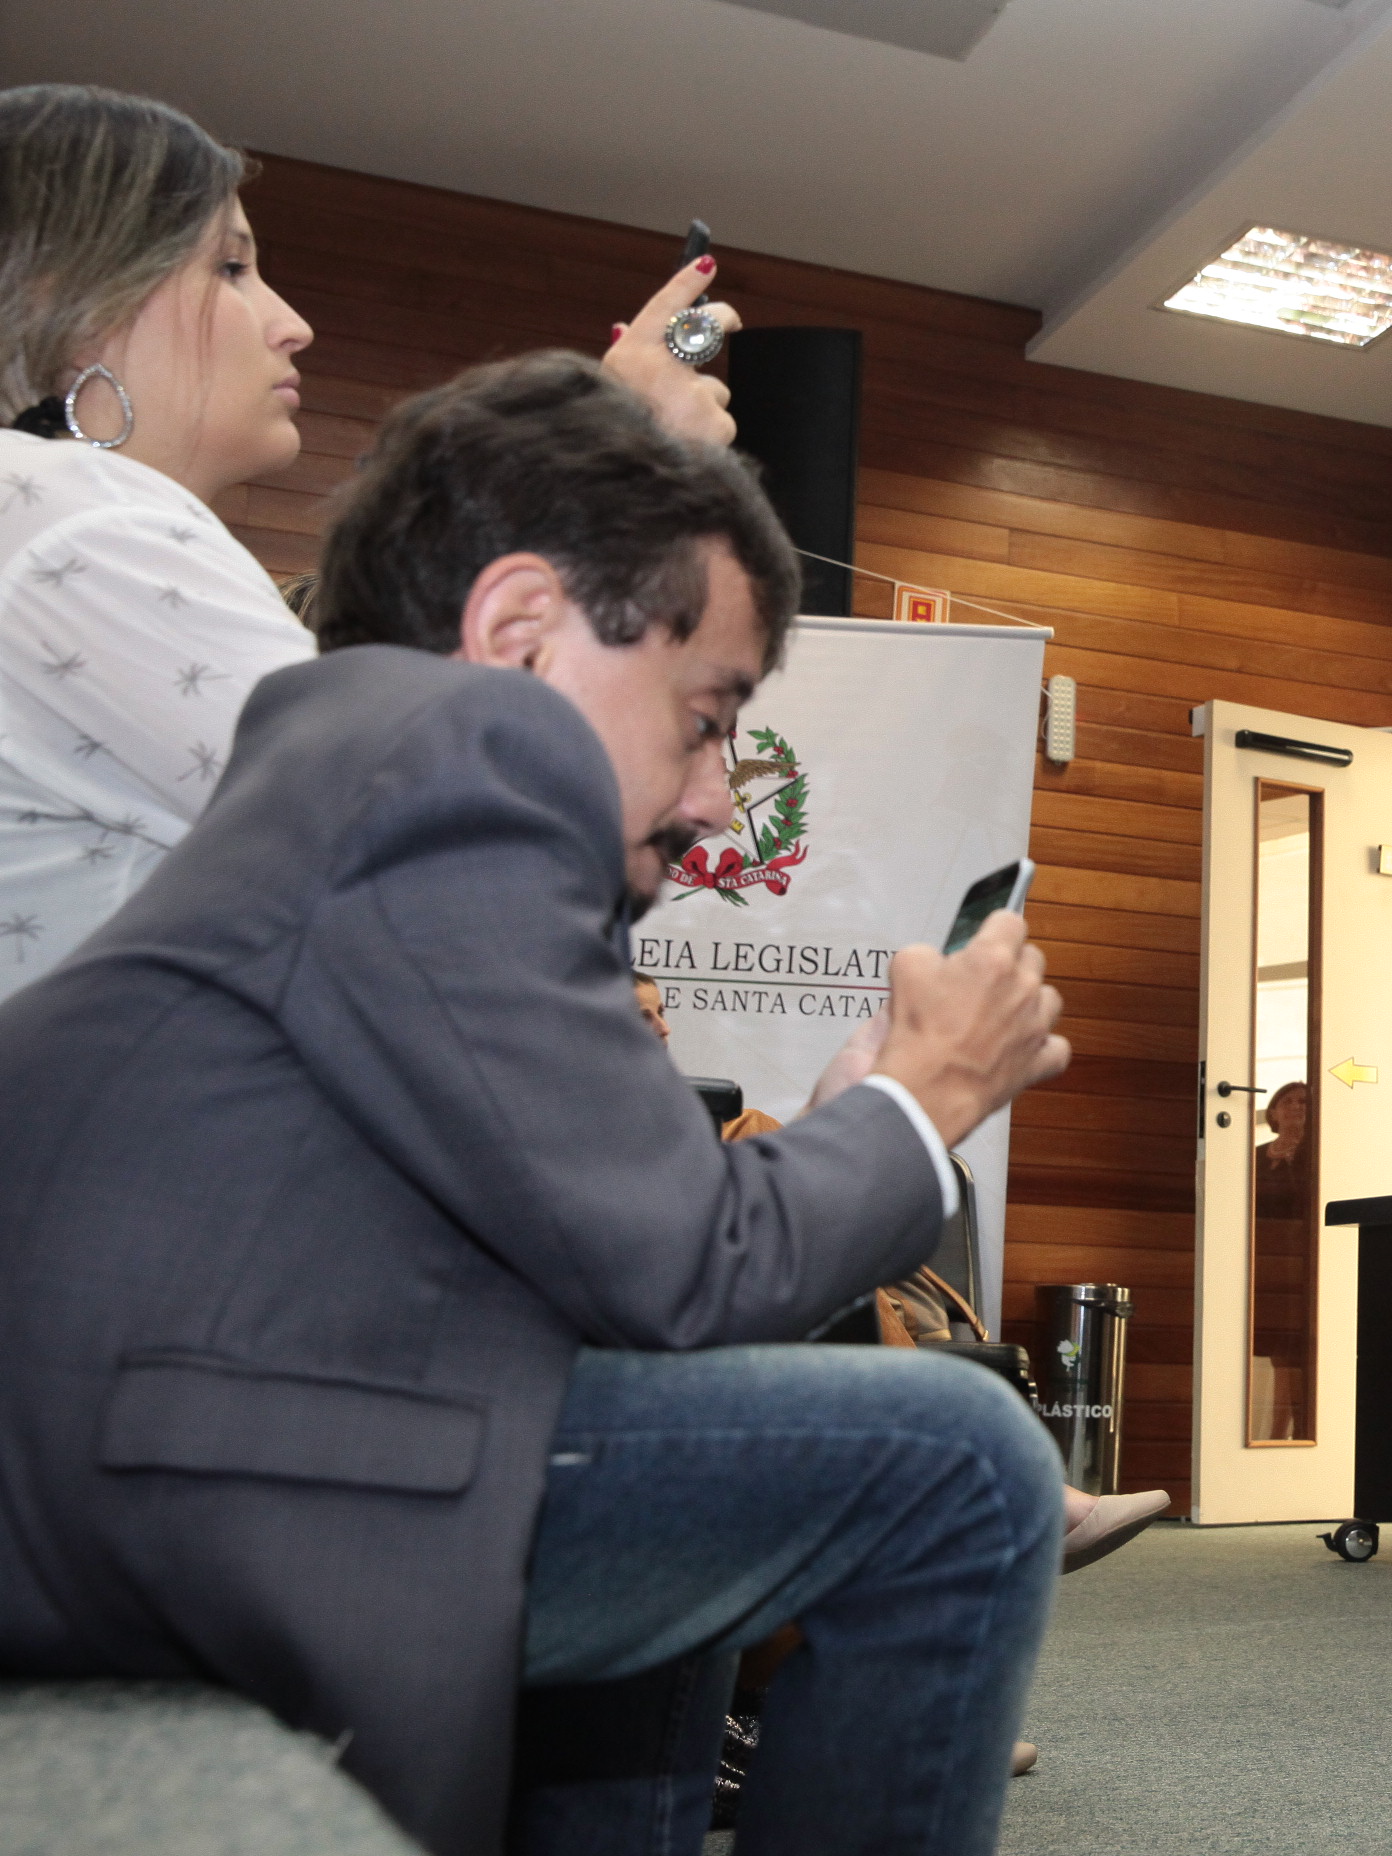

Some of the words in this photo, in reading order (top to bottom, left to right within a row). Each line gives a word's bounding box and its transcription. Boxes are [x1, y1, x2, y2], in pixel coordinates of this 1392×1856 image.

[630, 937, 698, 970] EIA
[711, 941, 899, 979] LEGISLAT
[664, 986, 682, 1010] E
[692, 986, 788, 1015] SANTA
